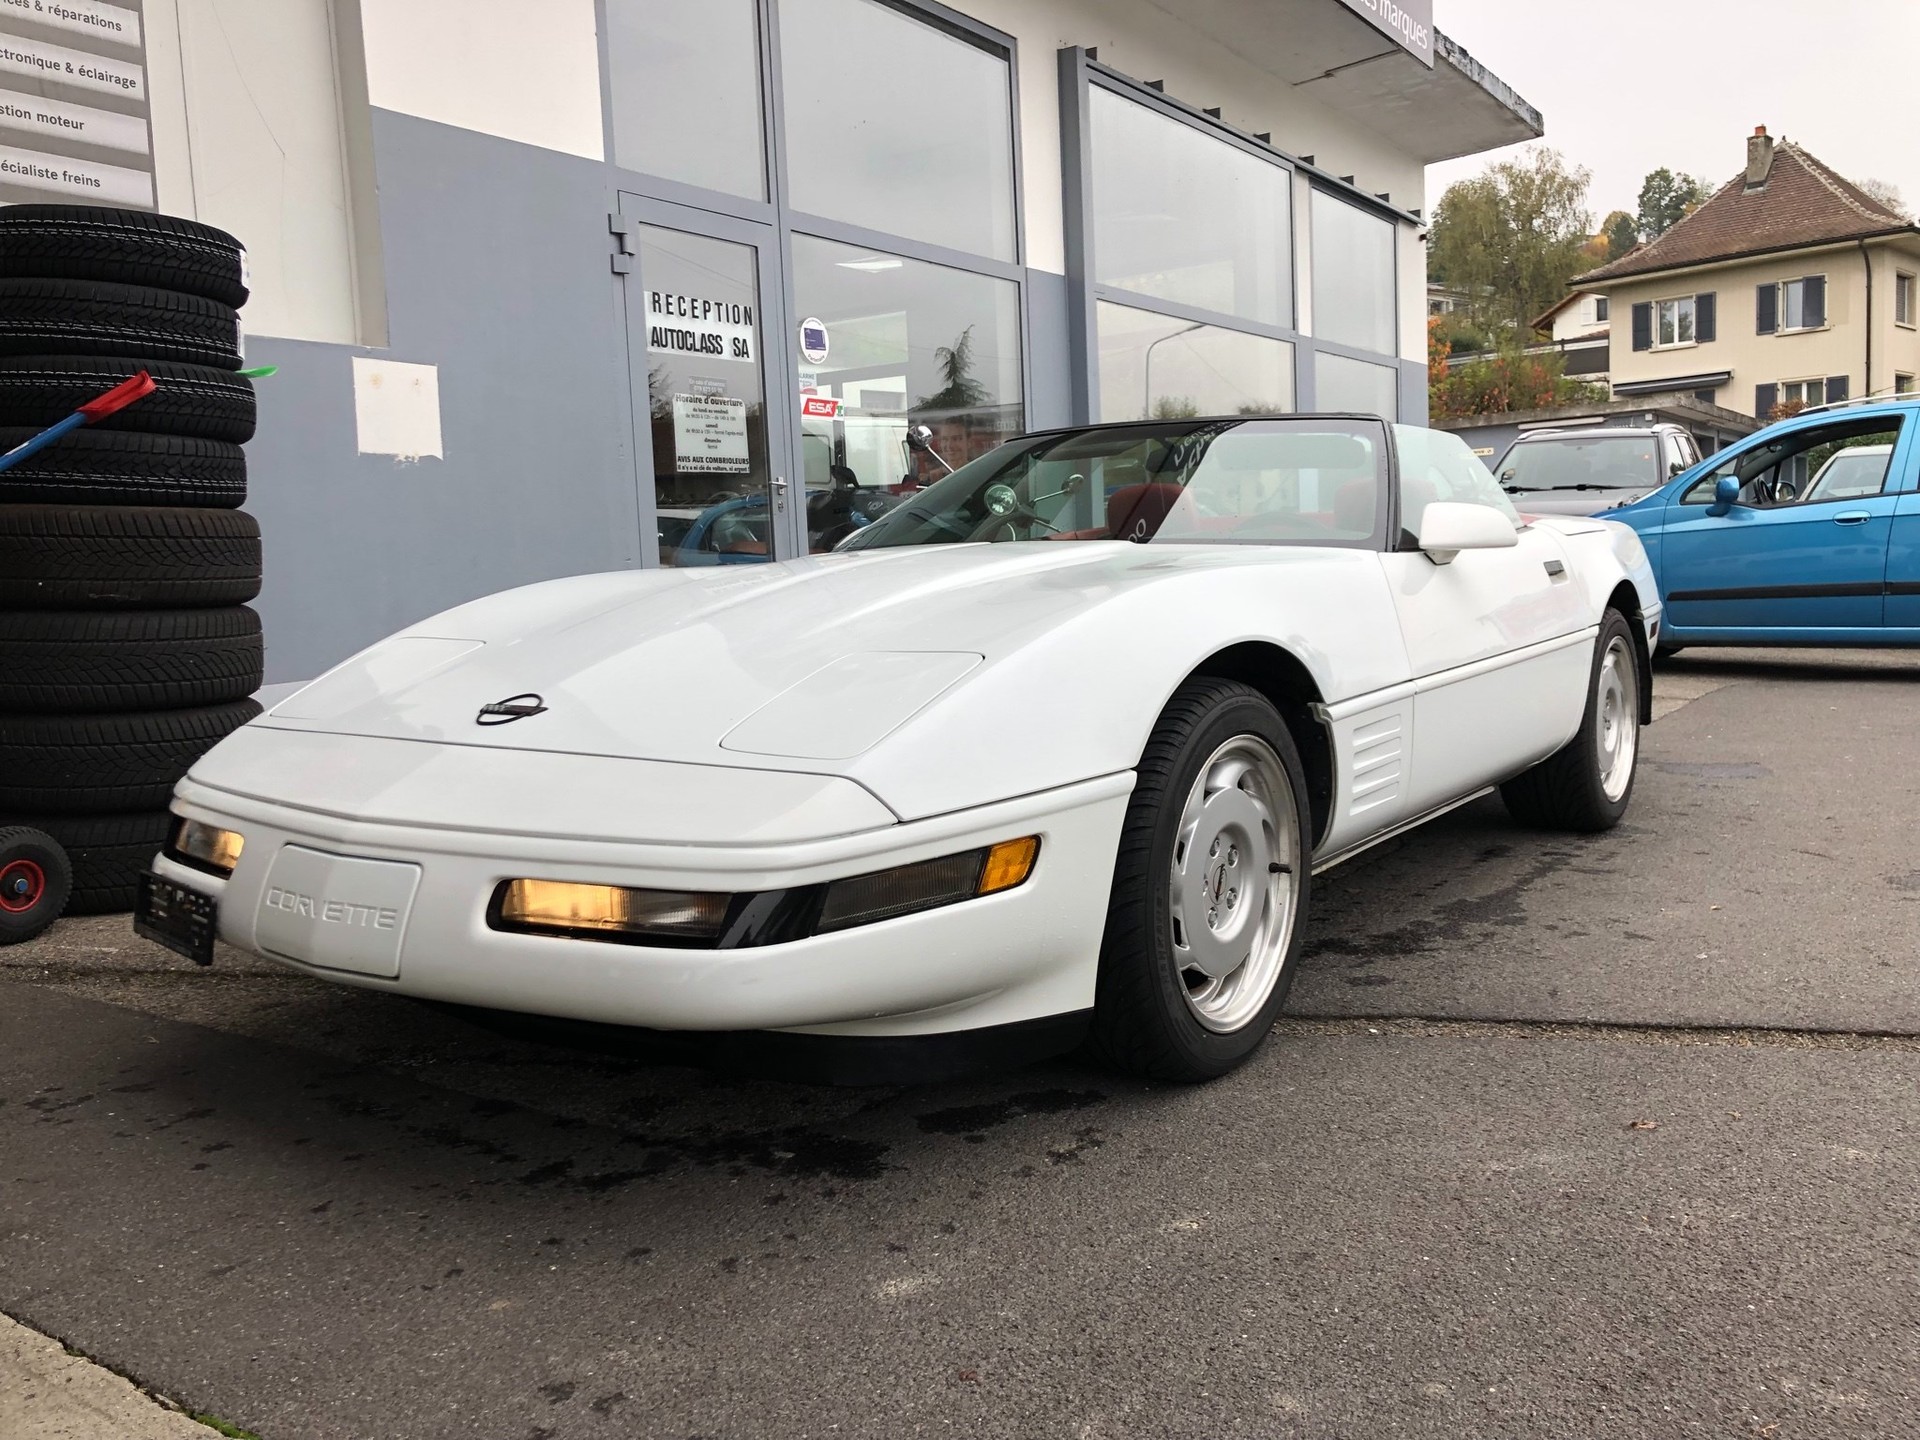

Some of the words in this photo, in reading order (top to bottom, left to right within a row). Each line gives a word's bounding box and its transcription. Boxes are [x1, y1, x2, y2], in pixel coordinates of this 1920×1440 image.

[34, 0, 43, 12] &
[48, 5, 122, 32] réparations
[65, 62, 74, 74] &
[78, 65, 137, 89] éclairage
[36, 113, 85, 130] moteur
[62, 171, 101, 187] freins
[652, 291, 753, 326] RECEPTION
[651, 326, 723, 355] AUTOCLASS
[732, 337, 750, 359] SA
[676, 395, 703, 404] Horaire
[704, 395, 744, 407] d'ouverture
[266, 886, 398, 930] CORVETTE
